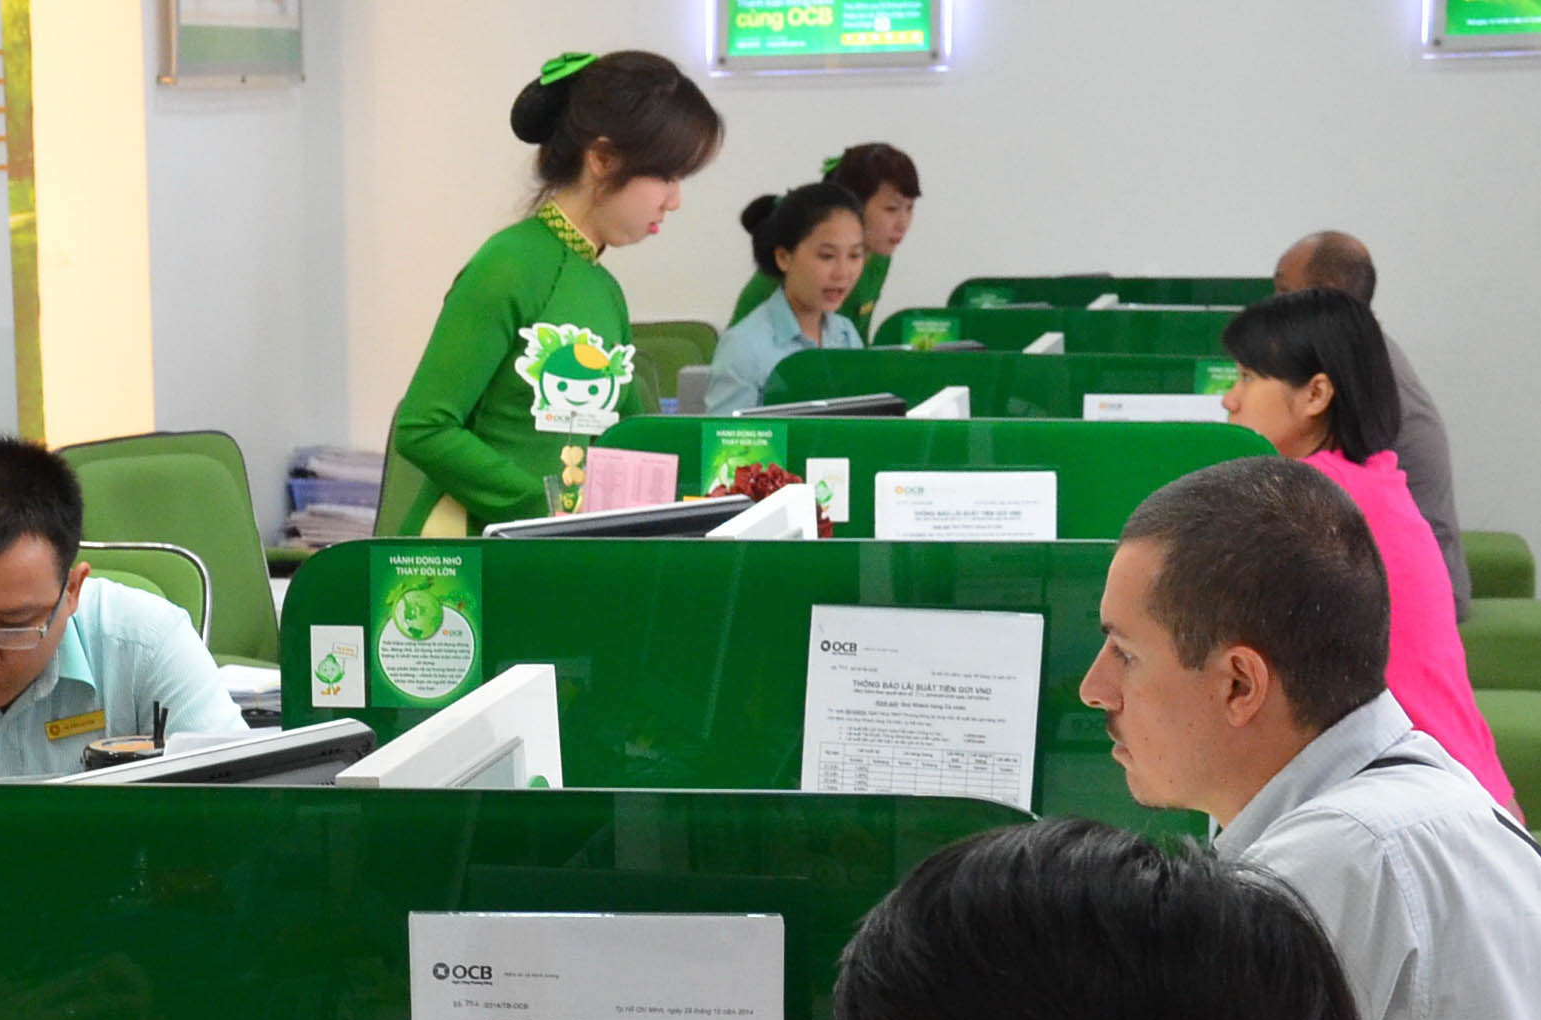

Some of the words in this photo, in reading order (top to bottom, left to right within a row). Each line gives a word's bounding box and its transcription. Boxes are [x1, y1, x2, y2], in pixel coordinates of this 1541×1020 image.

[736, 8, 784, 31] cùng
[787, 6, 833, 27] OCB
[389, 553, 414, 565] HÀNH
[415, 556, 441, 566] ĐỘNG
[395, 566, 419, 576] THAY
[832, 641, 857, 652] OCB
[853, 679, 880, 688] THÔNG
[452, 963, 492, 979] OCB
